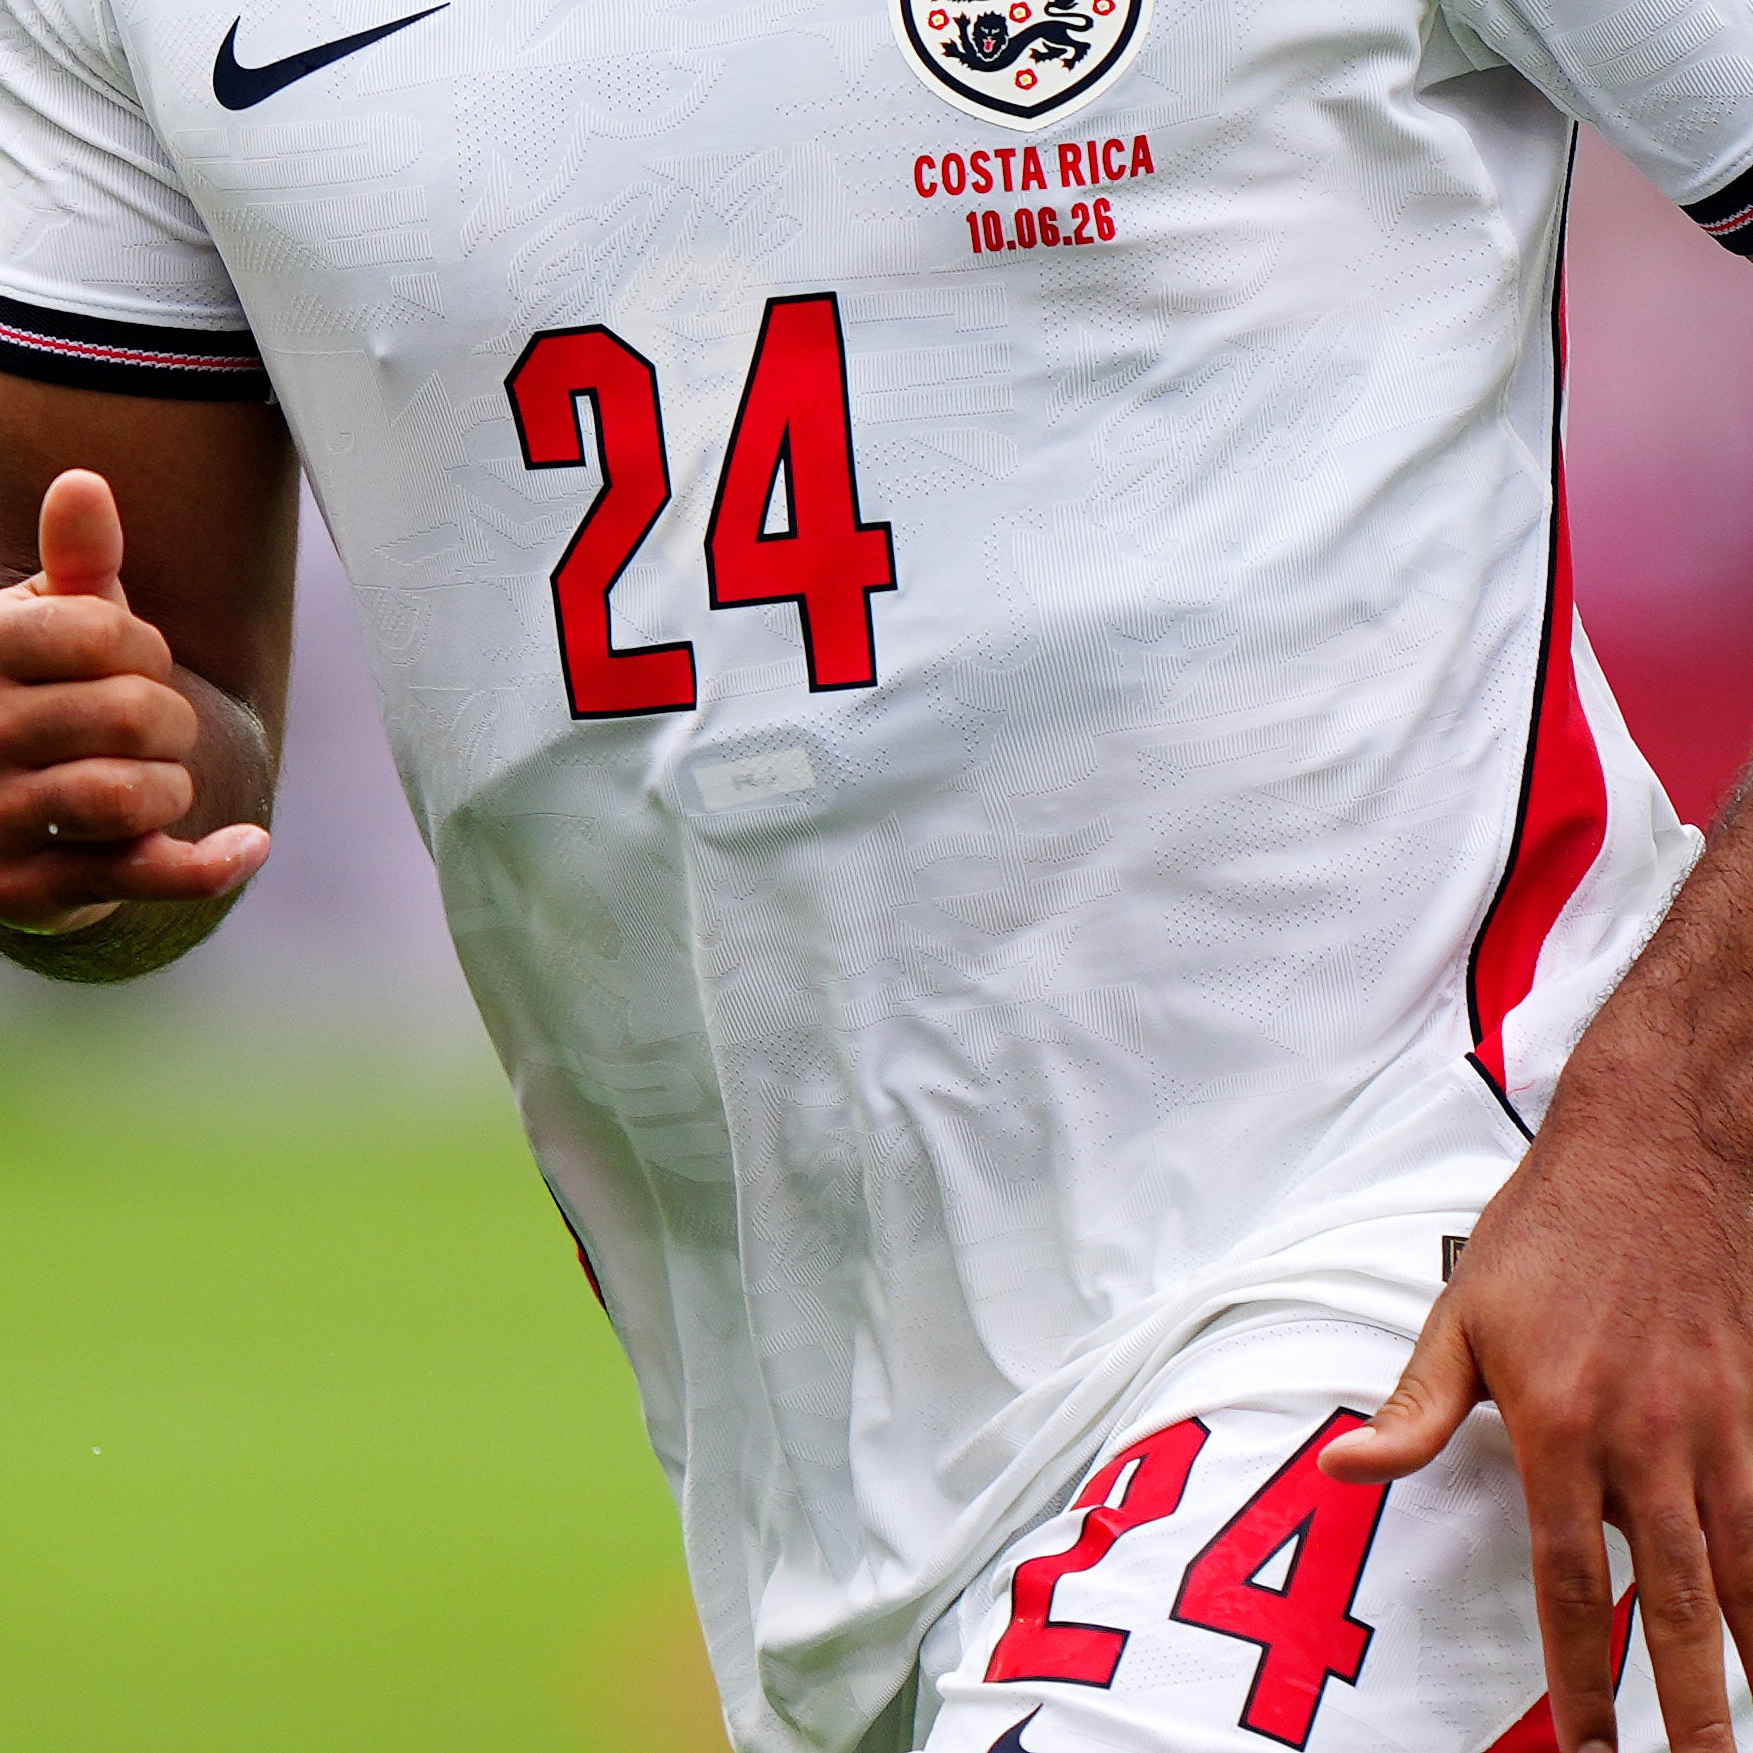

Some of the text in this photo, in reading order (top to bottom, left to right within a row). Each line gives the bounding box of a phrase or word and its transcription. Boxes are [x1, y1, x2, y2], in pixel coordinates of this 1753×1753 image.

[914, 134, 1154, 198] COSTA RICA
[966, 197, 1116, 253] 10.06.26
[503, 291, 898, 720] 24
[983, 1406, 1393, 1752] 24
